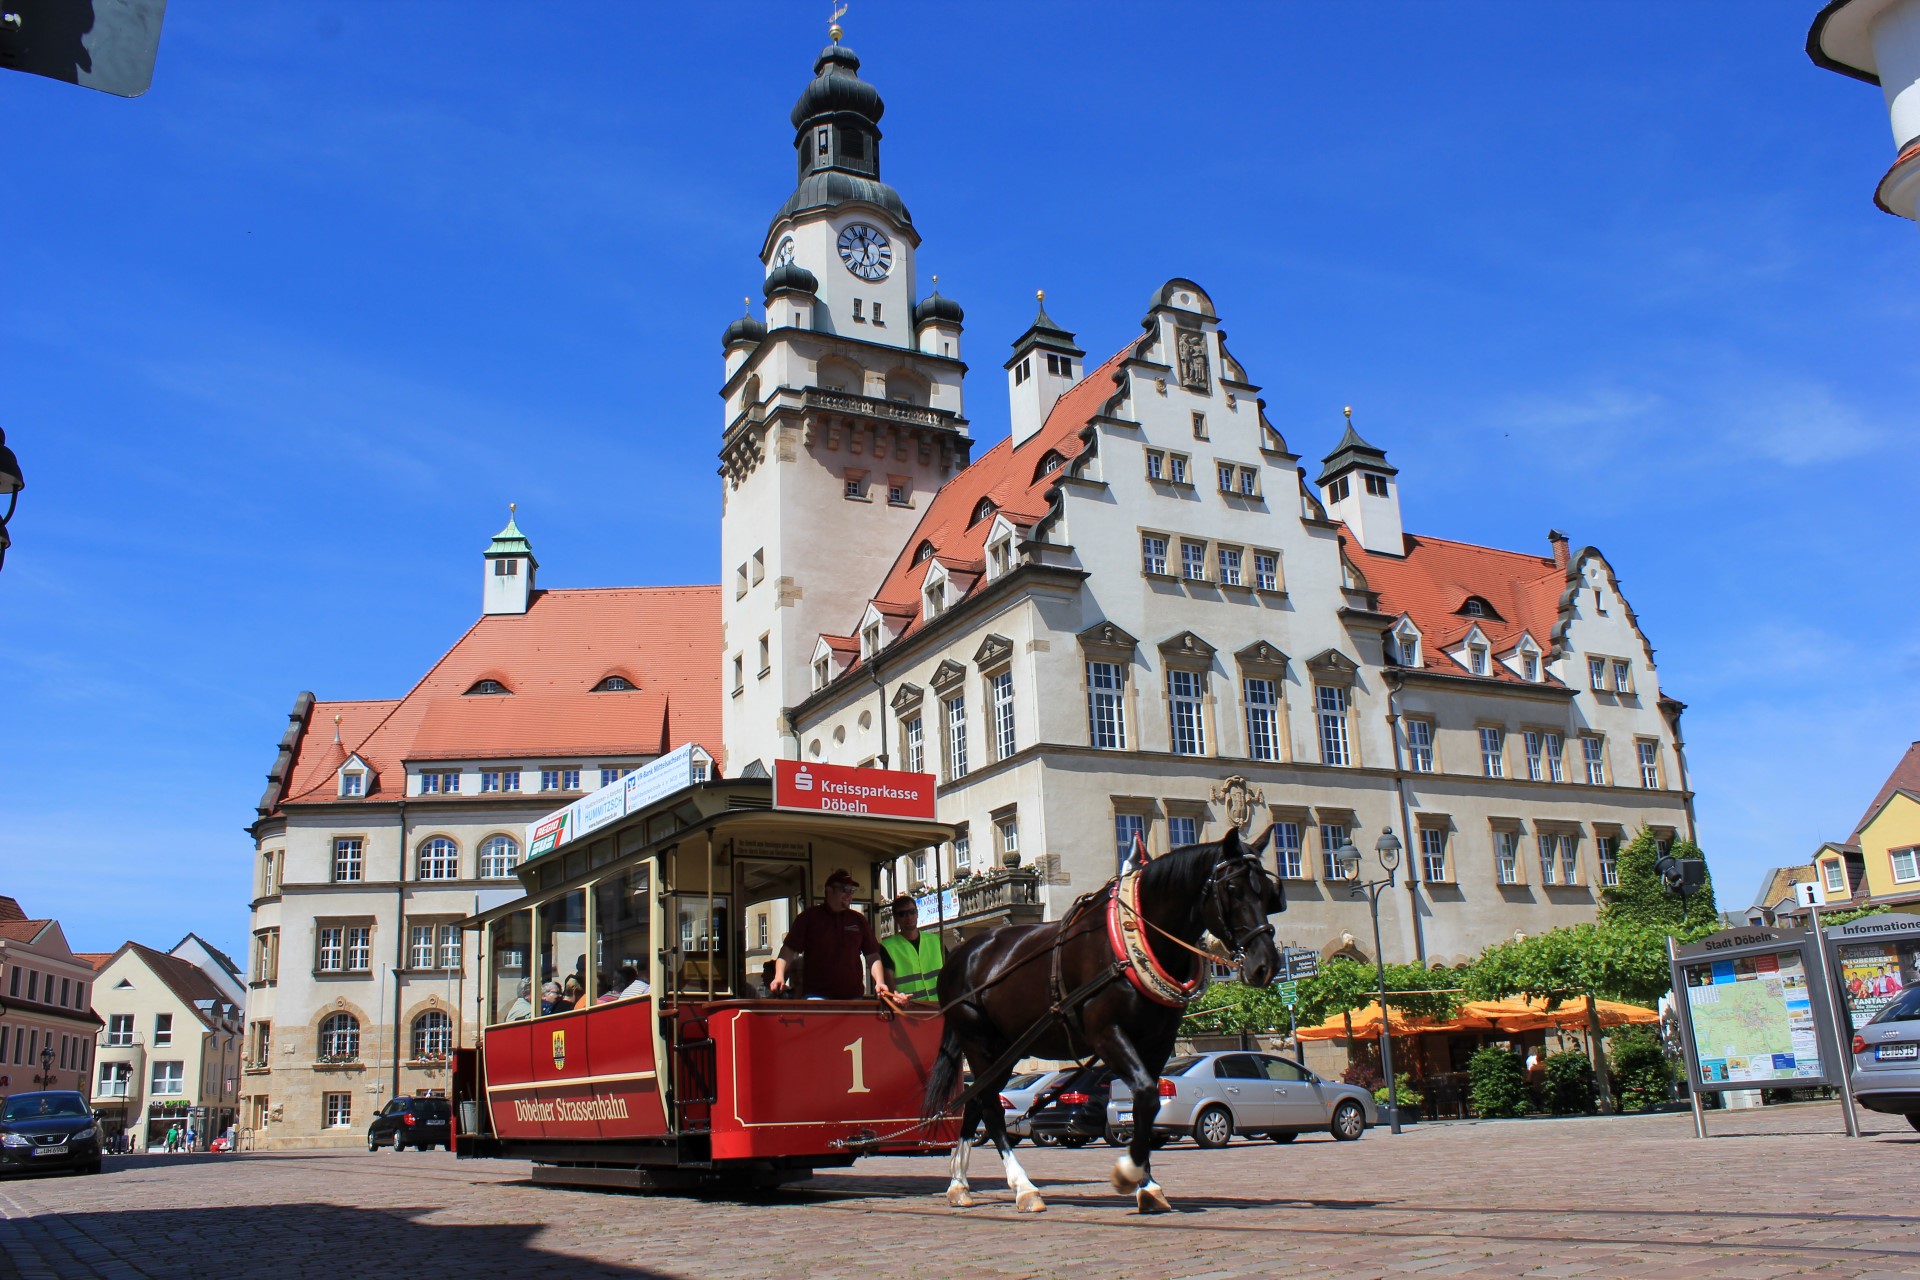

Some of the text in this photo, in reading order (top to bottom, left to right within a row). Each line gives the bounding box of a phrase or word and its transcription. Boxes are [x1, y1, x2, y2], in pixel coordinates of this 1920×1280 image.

[821, 780, 919, 800] Kreissparkasse
[585, 795, 623, 823] HUMMITZSCH
[821, 797, 868, 812] Döbeln
[1705, 932, 1772, 951] Stadt Döbeln
[1854, 997, 1893, 1006] FANTASY
[843, 1036, 871, 1094] 1
[164, 1099, 190, 1107] OPTIK
[514, 1093, 629, 1122] Döbelner Strassenbahn
